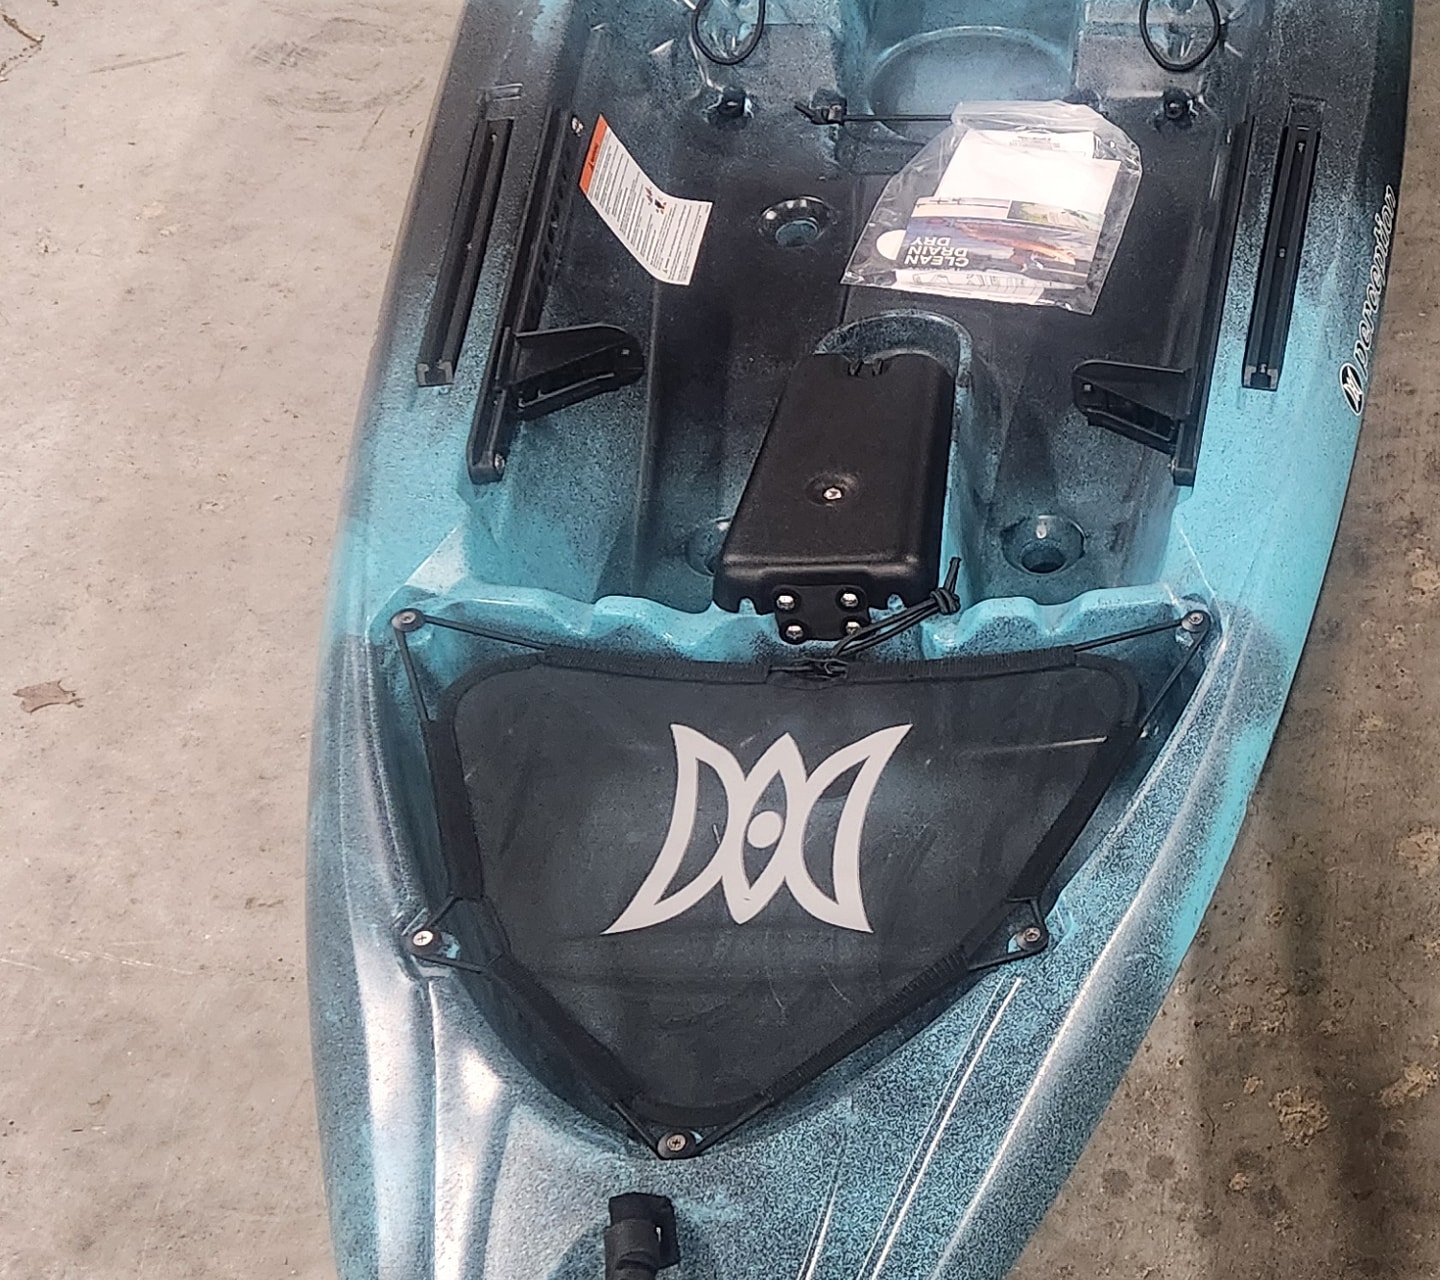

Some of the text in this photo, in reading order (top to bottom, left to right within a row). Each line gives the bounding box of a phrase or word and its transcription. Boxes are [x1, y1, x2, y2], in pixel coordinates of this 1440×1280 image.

[910, 235, 952, 248] DRY
[906, 245, 969, 259] DRAIN
[903, 254, 970, 268] CLEAN
[1353, 184, 1397, 378] perception
